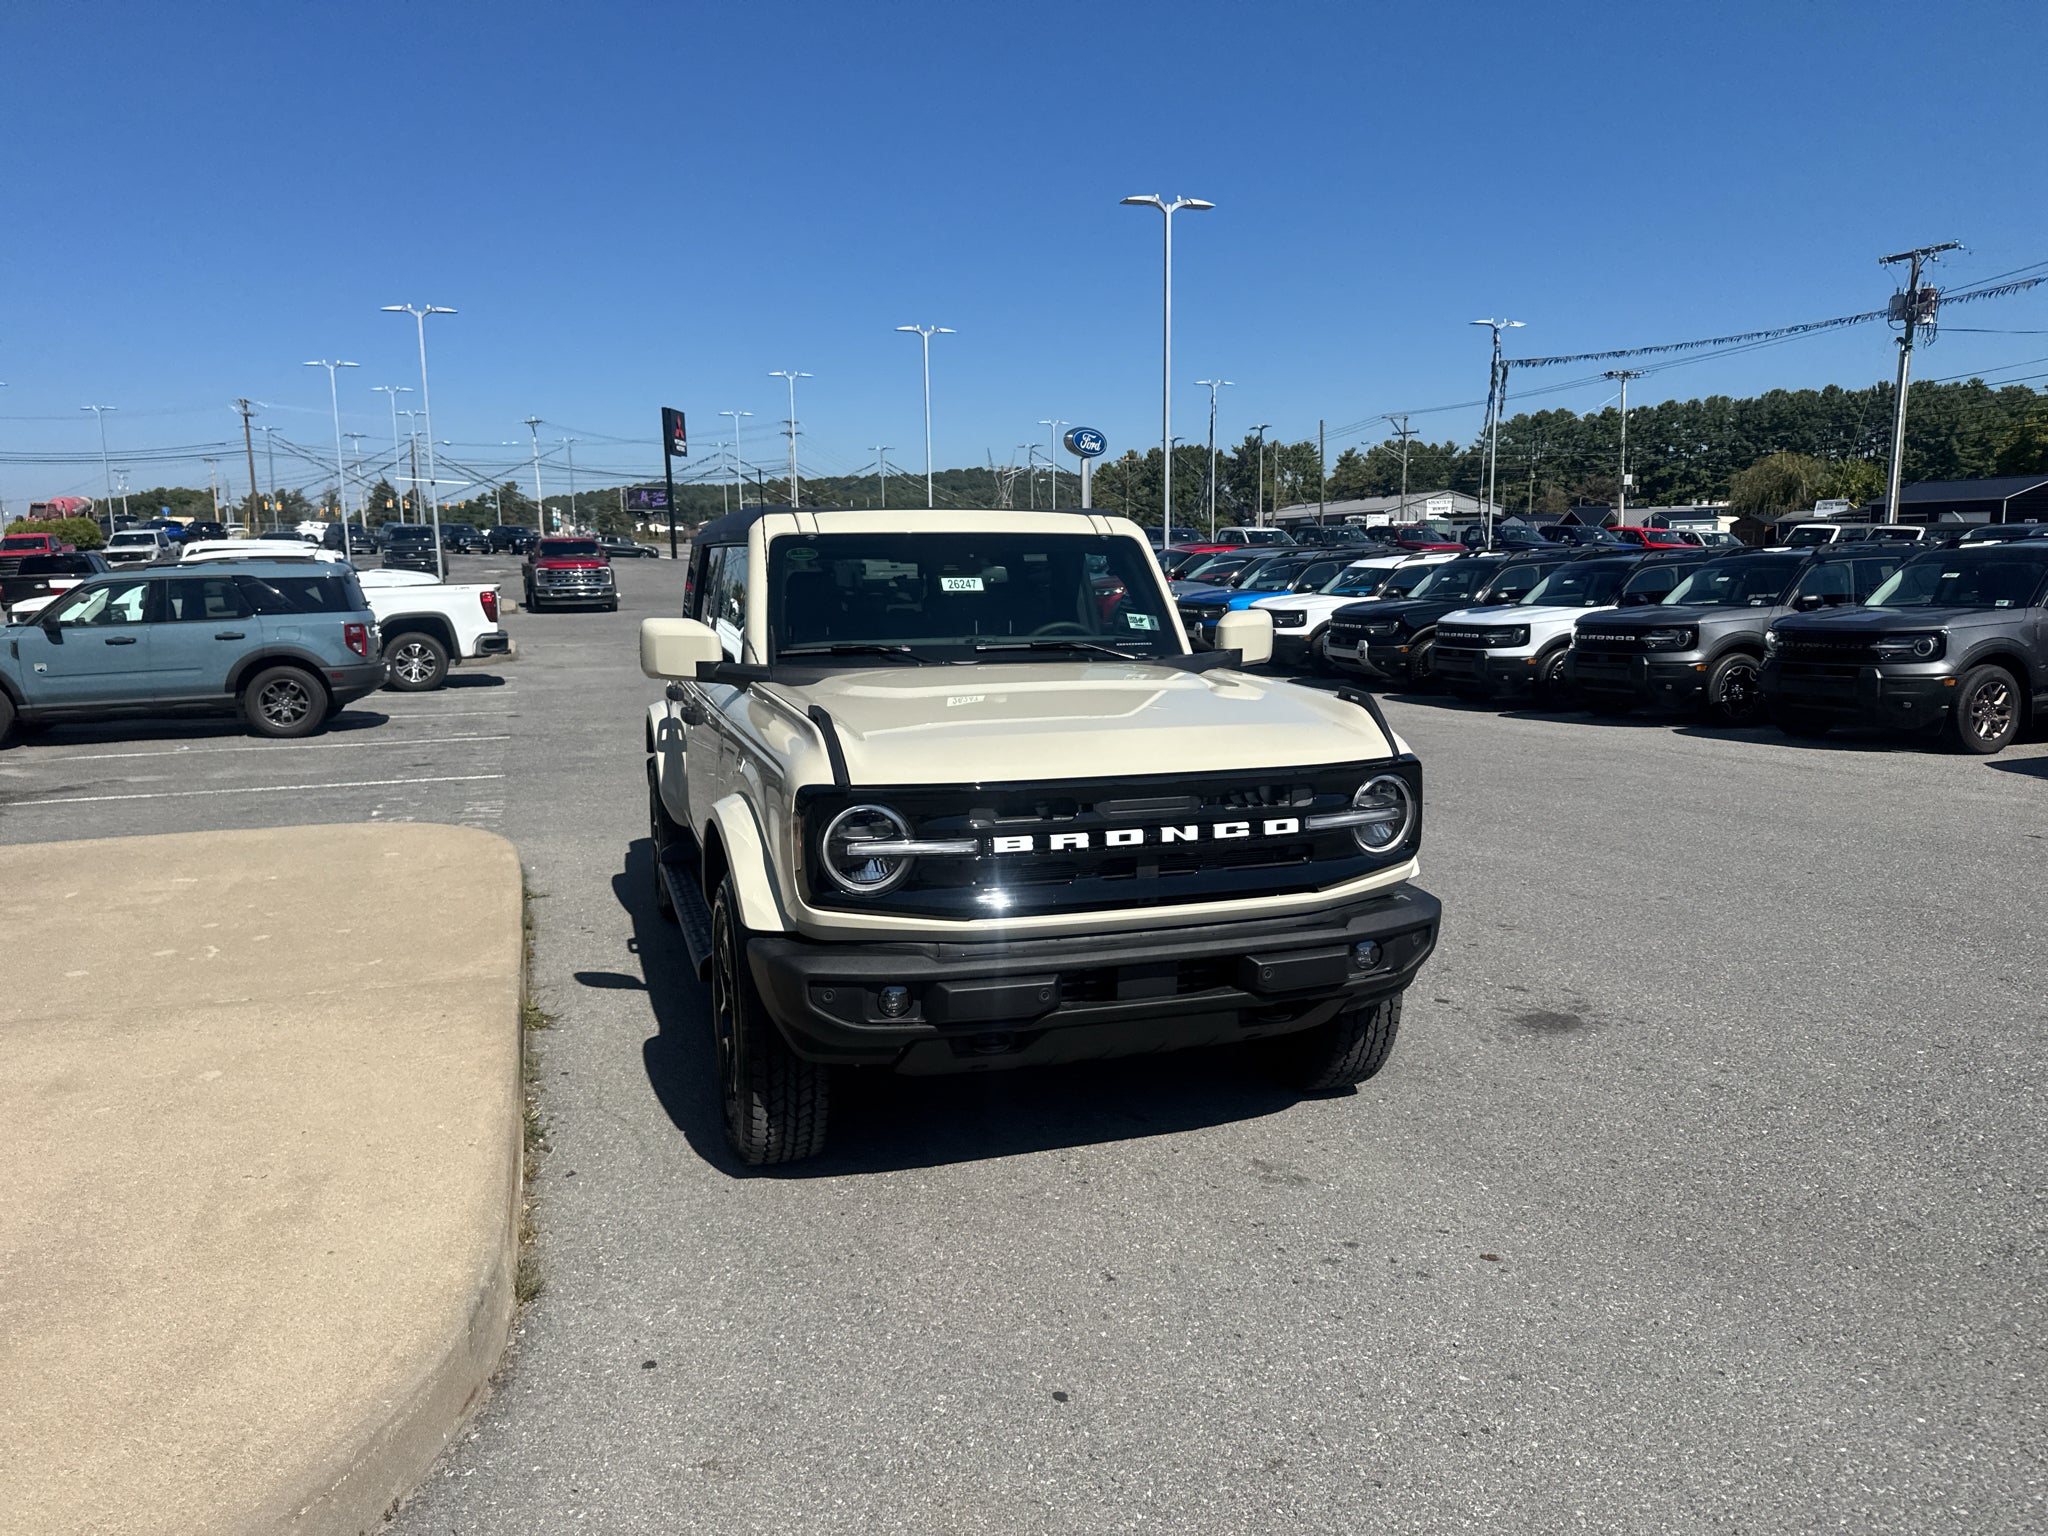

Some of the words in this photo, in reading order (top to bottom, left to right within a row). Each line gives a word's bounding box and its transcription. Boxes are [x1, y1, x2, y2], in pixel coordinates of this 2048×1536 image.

[1080, 433, 1102, 451] Ford
[947, 579, 976, 589] 26247
[993, 818, 1299, 853] BRONCO
